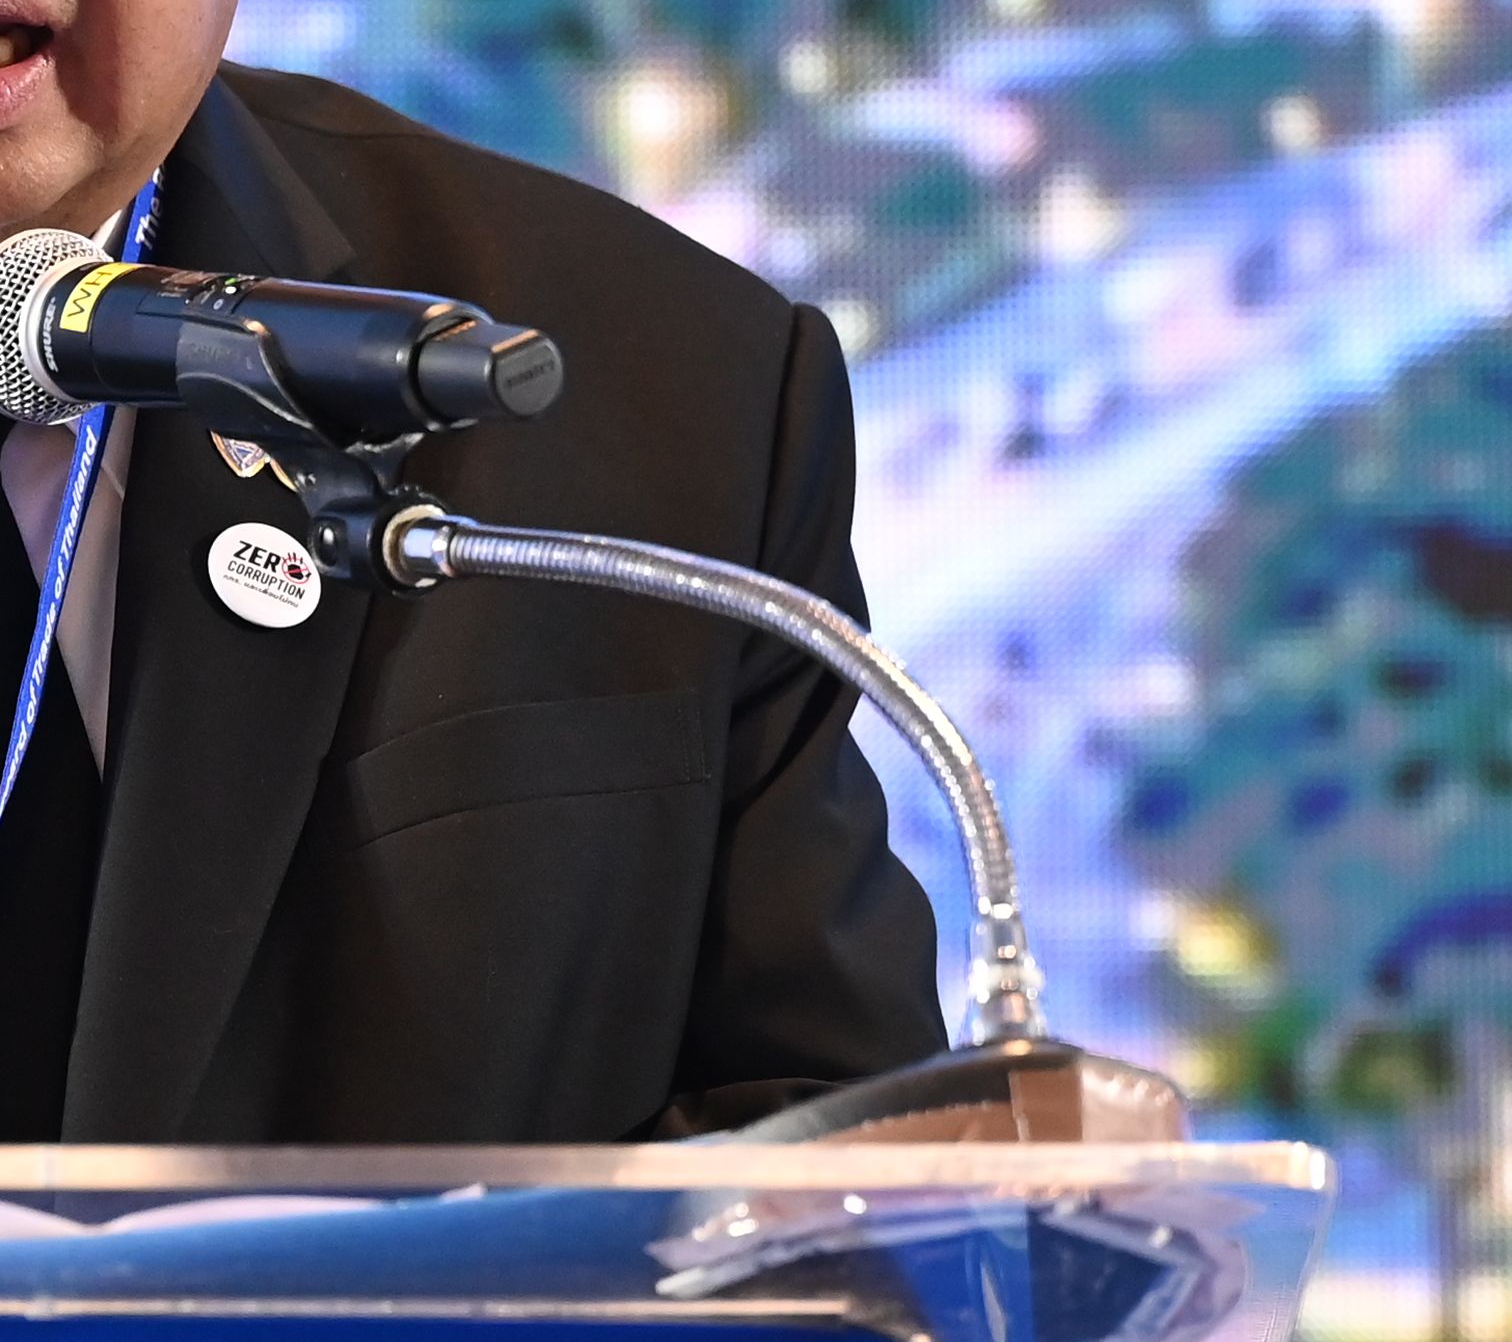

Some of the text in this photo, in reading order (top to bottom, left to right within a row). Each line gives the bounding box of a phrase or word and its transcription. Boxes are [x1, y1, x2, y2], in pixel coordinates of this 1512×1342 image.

[42, 301, 59, 373] SHURE
[60, 424, 100, 562] Thailand
[227, 559, 306, 600] CORRUPTION
